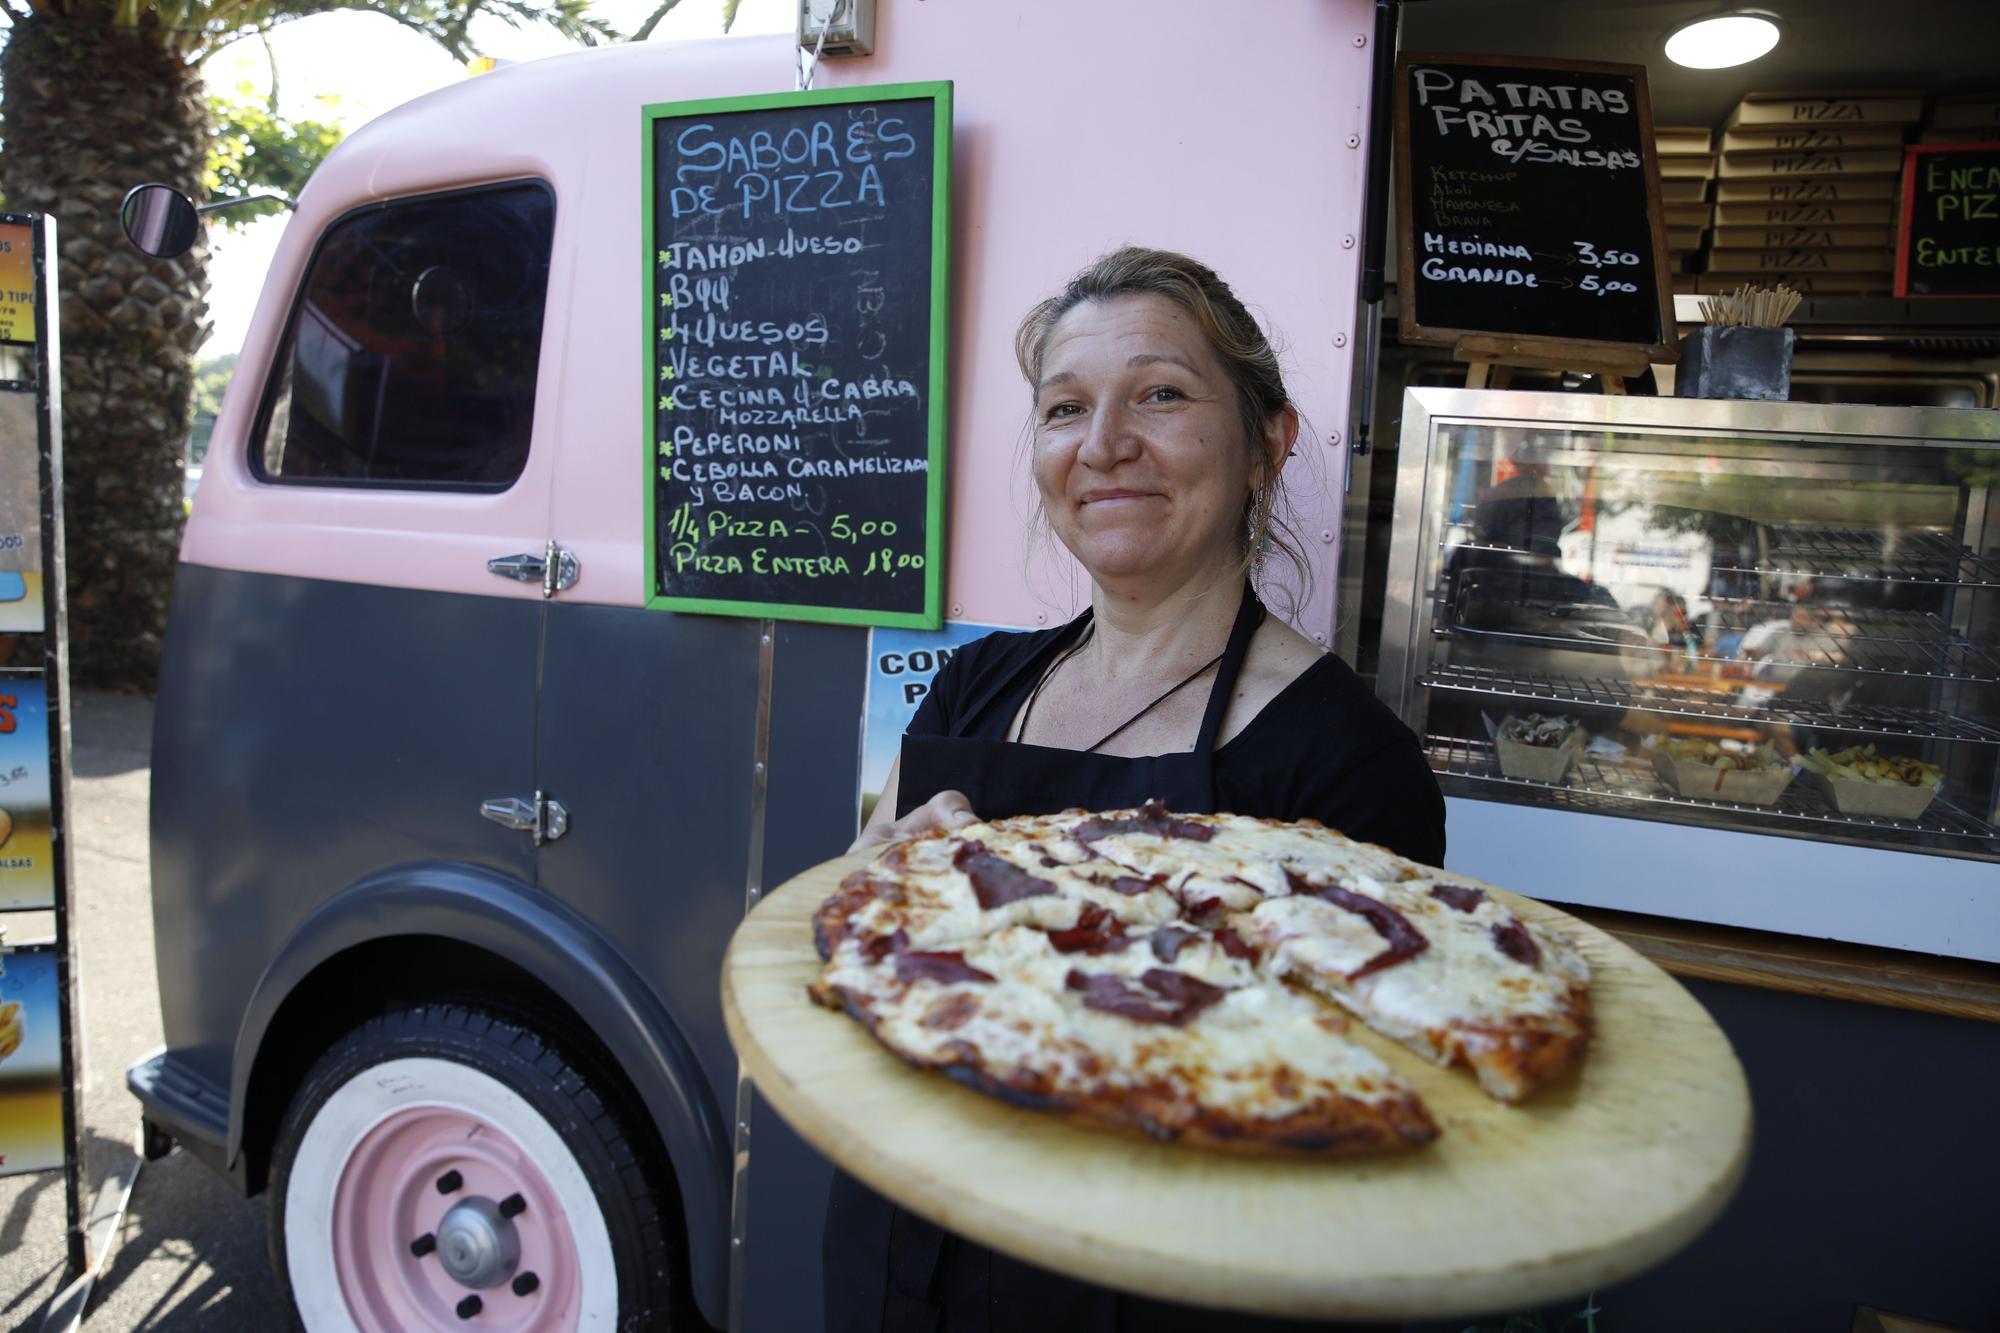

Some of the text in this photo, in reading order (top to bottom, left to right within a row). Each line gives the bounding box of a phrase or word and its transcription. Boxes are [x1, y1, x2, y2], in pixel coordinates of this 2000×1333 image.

[1414, 68, 1629, 114] PATATAS
[1793, 105, 1865, 119] PIZZA
[677, 119, 916, 182] SABORES
[670, 164, 885, 218] DE PIZZA
[1573, 241, 1639, 269] 3,50
[1421, 258, 1638, 296] GRANDE 5,00
[670, 346, 812, 379] VEGETAL
[671, 385, 785, 410] CECINA
[821, 379, 916, 401] CABRA
[720, 404, 861, 425] MOZZARELLA
[674, 425, 800, 456] PEPERONI
[673, 459, 778, 481] CEBOLLA
[667, 502, 699, 543] 1/4
[831, 514, 897, 544] 5,00
[669, 542, 925, 578] PIZZA ENTERA 18,00
